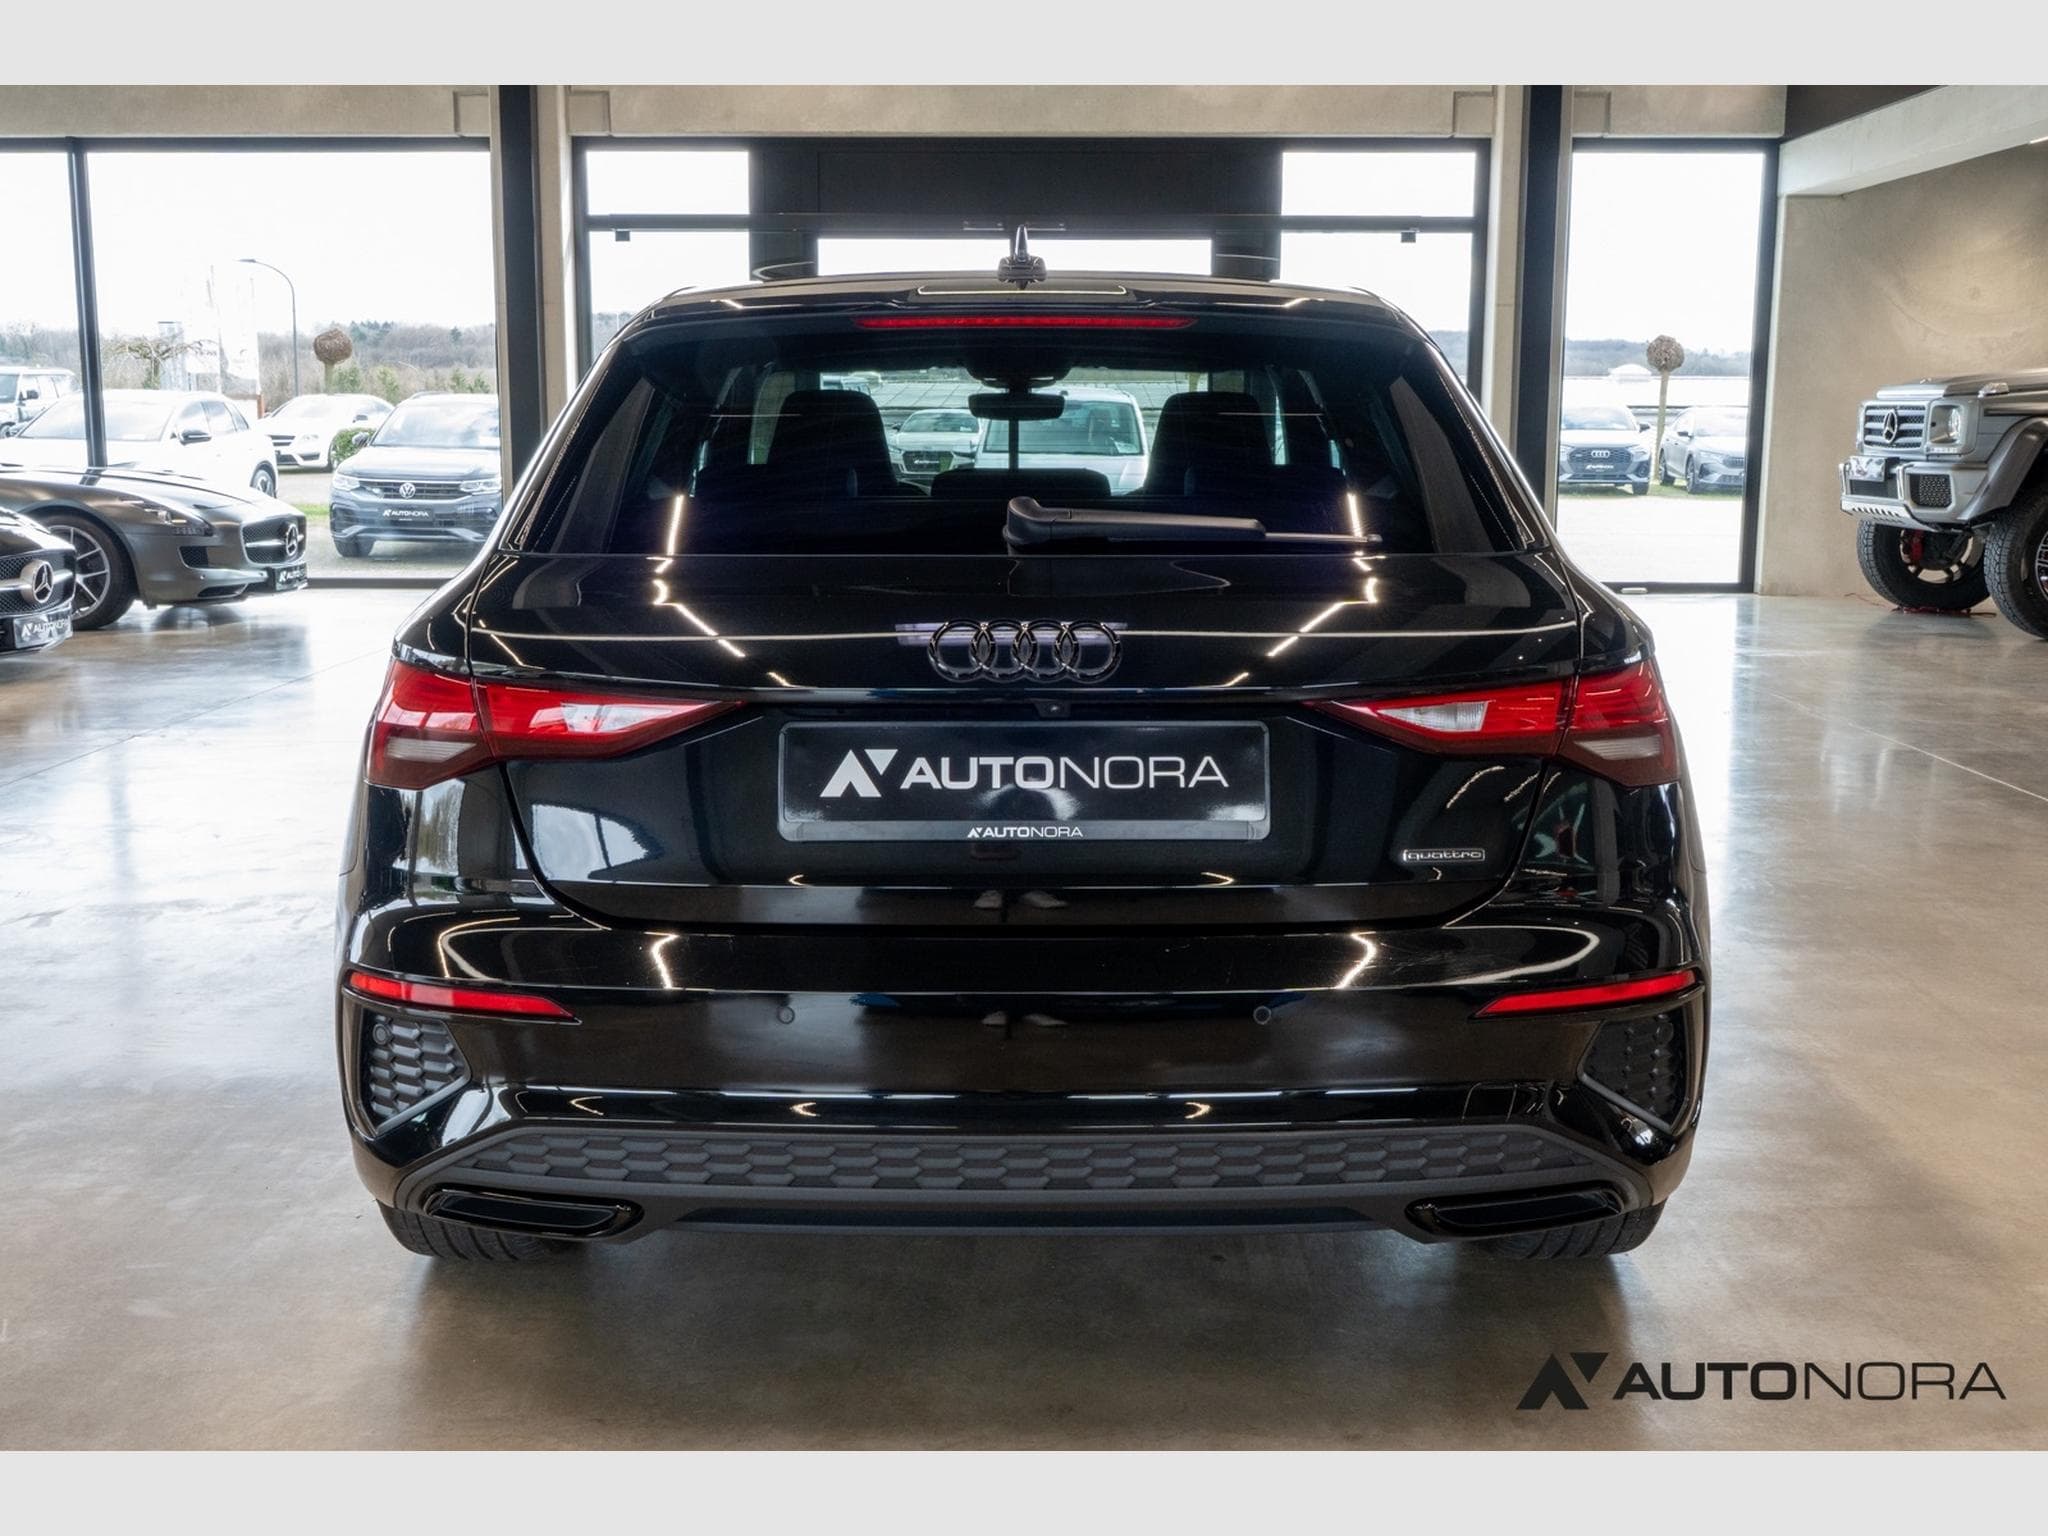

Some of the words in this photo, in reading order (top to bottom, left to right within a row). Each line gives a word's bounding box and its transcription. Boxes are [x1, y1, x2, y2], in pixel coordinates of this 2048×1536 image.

[900, 756, 1229, 790] AUTONORA
[982, 826, 1084, 838] AUTONORA
[1407, 850, 1482, 861] quattro
